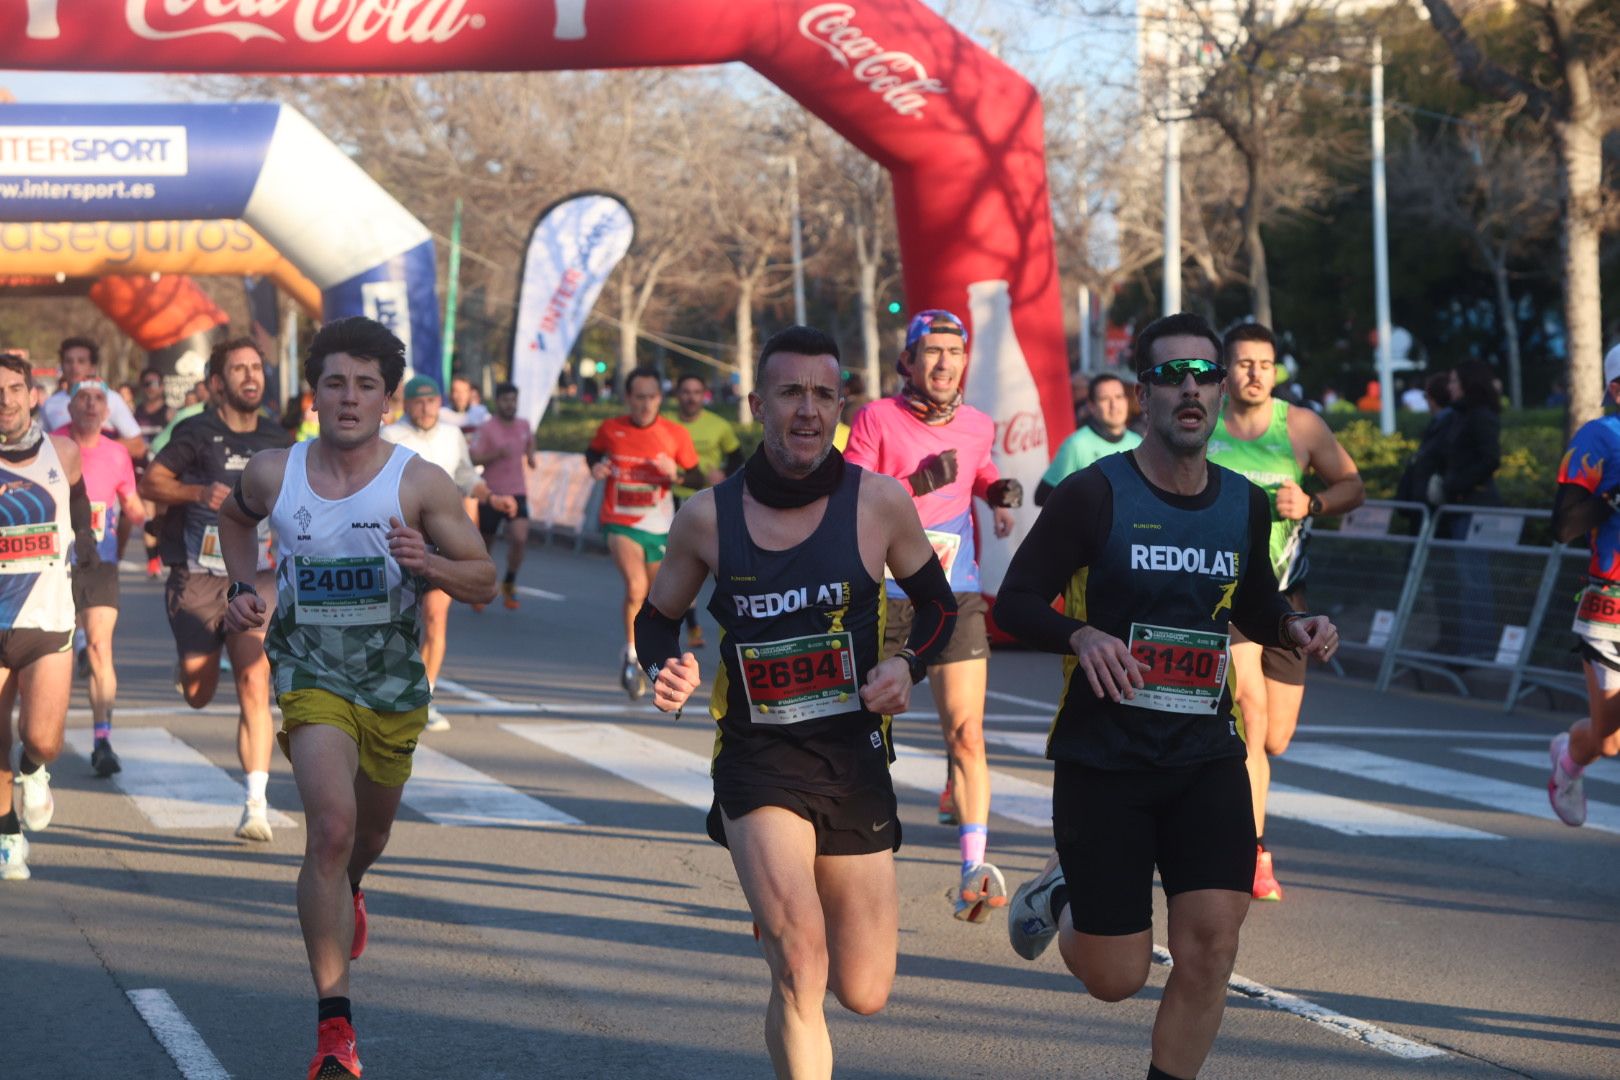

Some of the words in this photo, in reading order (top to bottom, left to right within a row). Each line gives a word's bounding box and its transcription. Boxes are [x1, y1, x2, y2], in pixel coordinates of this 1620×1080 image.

[798, 3, 948, 119] Coca-Cola
[0, 137, 171, 162] TERSPORT
[0, 535, 50, 553] 3058
[1131, 544, 1235, 577] REDOLAT
[299, 568, 374, 592] 2400
[732, 582, 843, 619] REDOLAT
[748, 652, 838, 689] 2694
[1136, 645, 1214, 678] 3140
